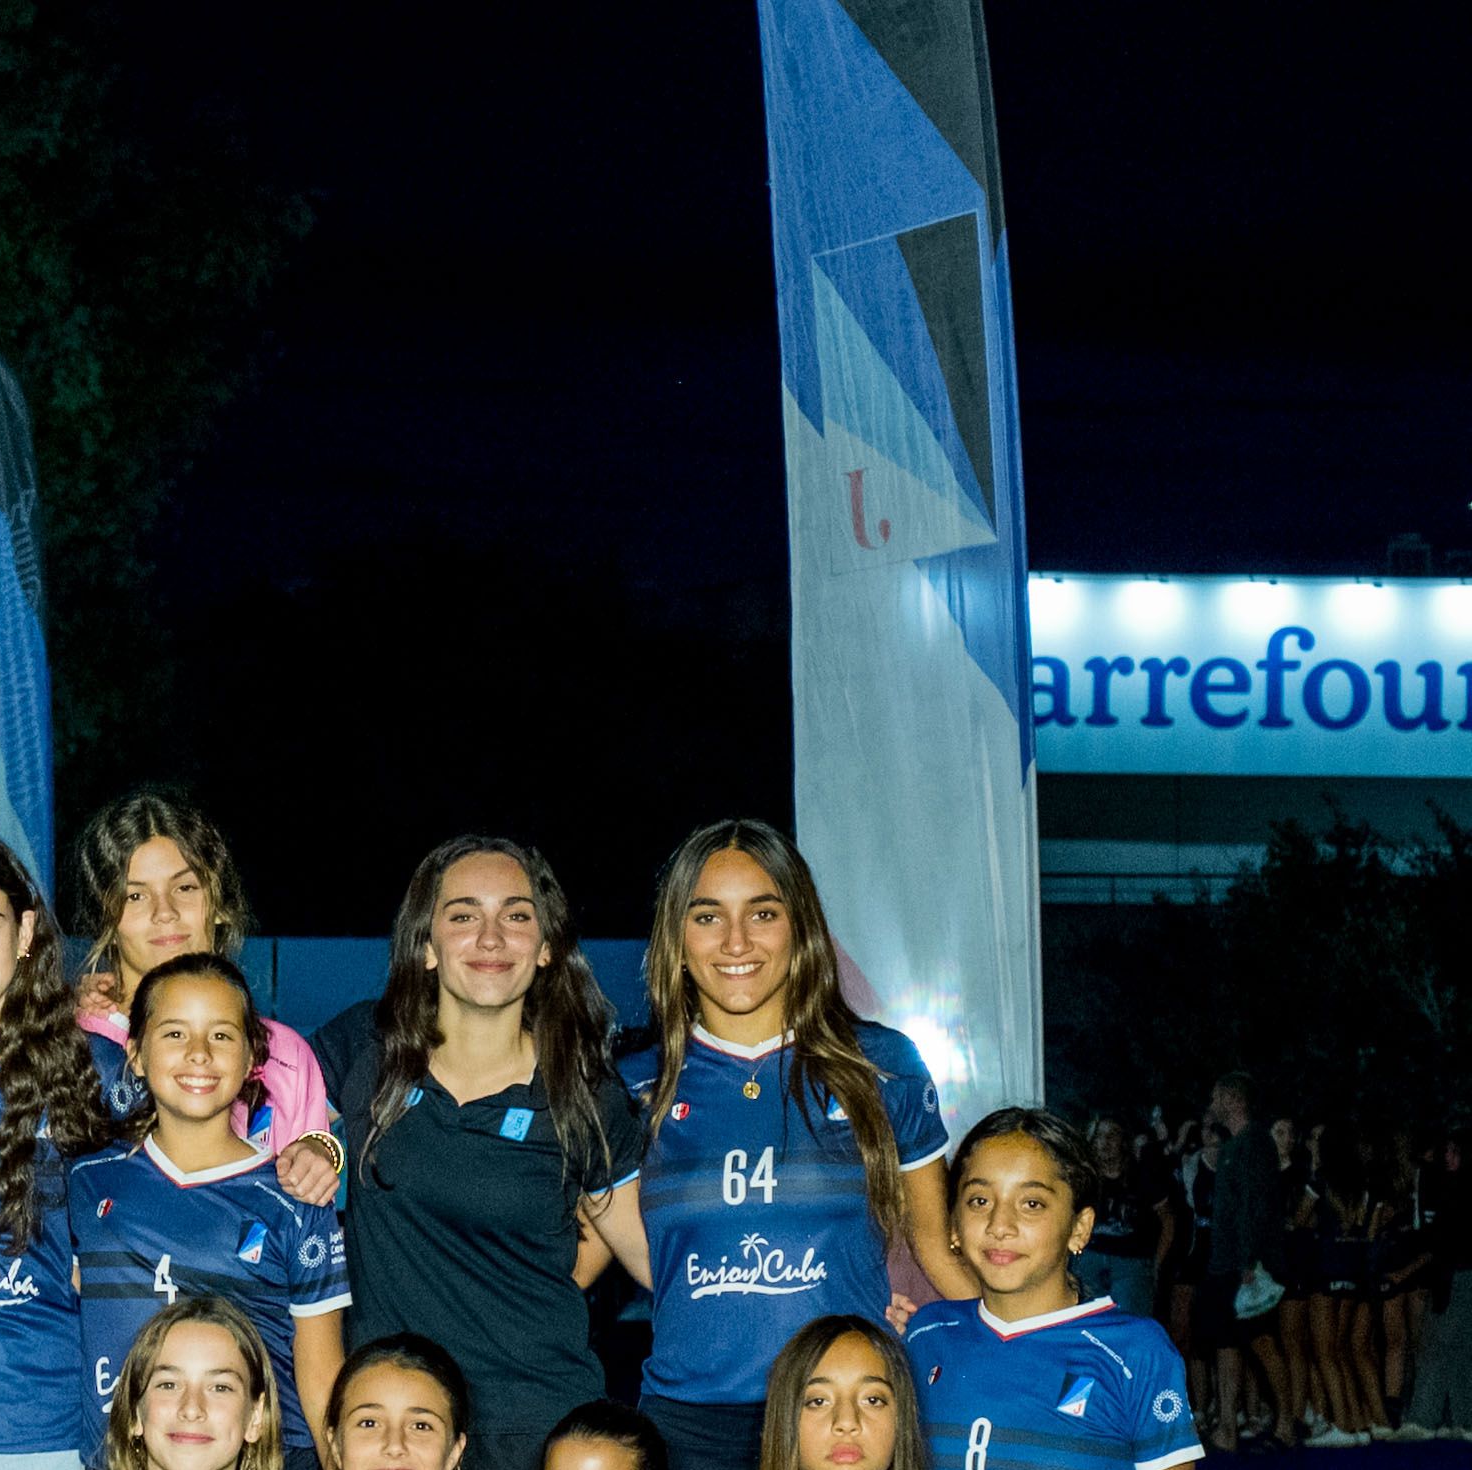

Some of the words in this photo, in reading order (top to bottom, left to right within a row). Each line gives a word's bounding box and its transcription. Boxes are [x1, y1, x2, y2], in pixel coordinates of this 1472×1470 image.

[1031, 626, 1472, 732] arrefou
[722, 1145, 778, 1206] 64
[153, 1253, 179, 1304] 4
[687, 1252, 762, 1292] Enjoy
[762, 1246, 827, 1283] Cuba
